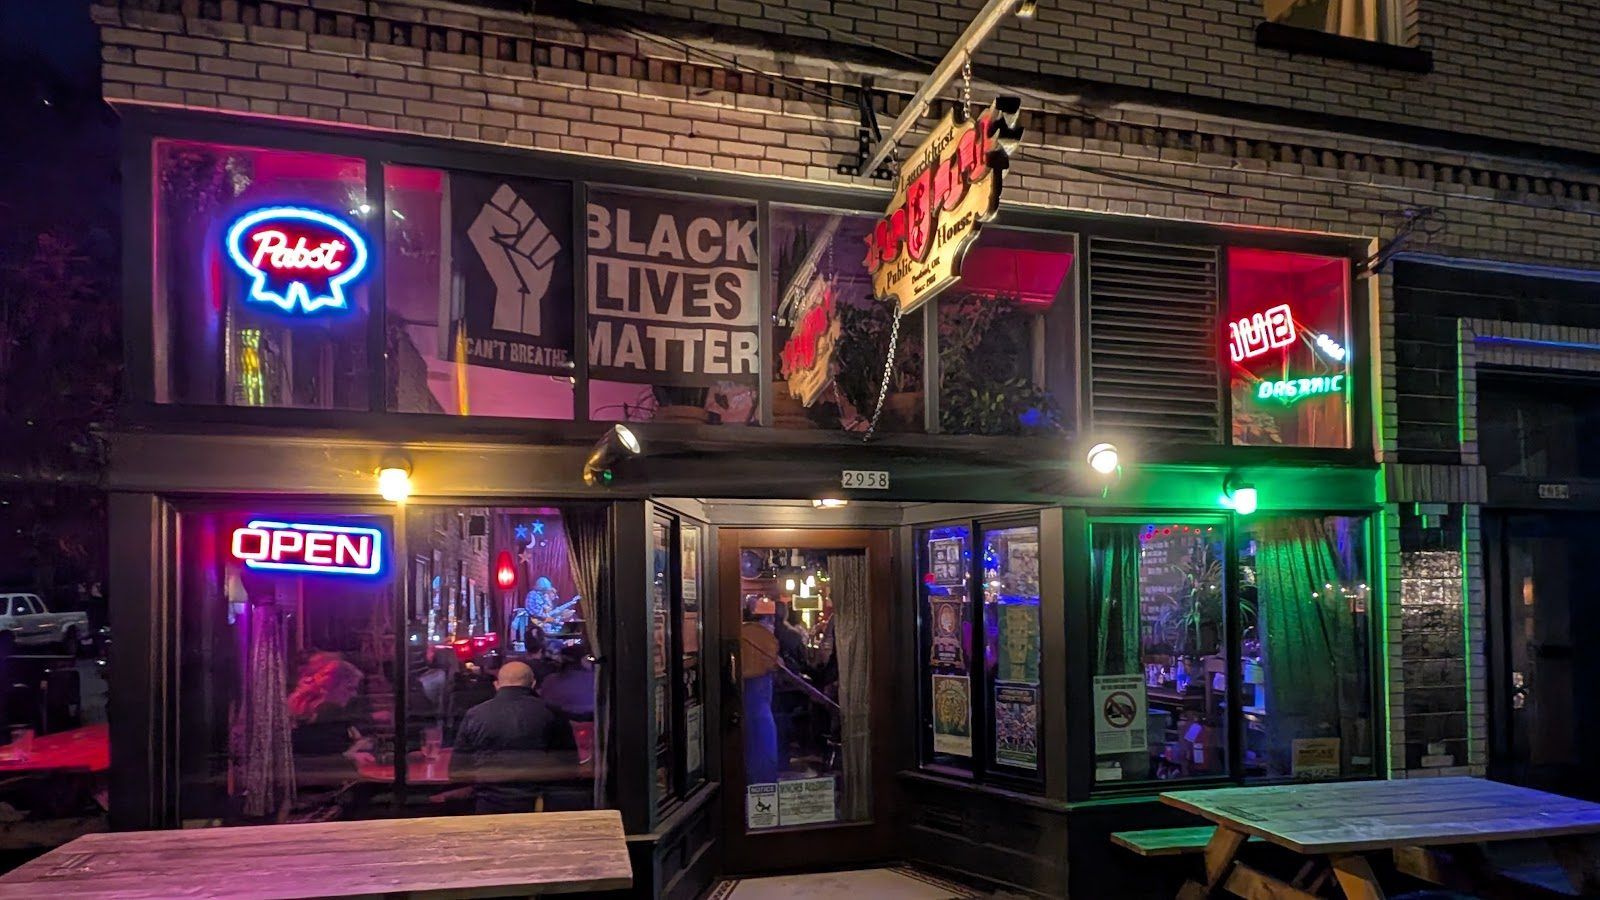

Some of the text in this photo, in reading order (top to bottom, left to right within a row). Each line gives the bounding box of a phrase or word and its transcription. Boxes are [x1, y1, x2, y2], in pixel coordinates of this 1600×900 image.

[252, 230, 346, 270] Pabst
[587, 203, 758, 264] BLACK
[887, 258, 912, 290] Public
[937, 211, 972, 248] House
[596, 262, 741, 320] LIVES
[465, 337, 570, 367] CAN'T BREATHE
[588, 321, 759, 374] MATTER
[843, 472, 888, 488] 2958
[231, 527, 370, 567] OPEN
